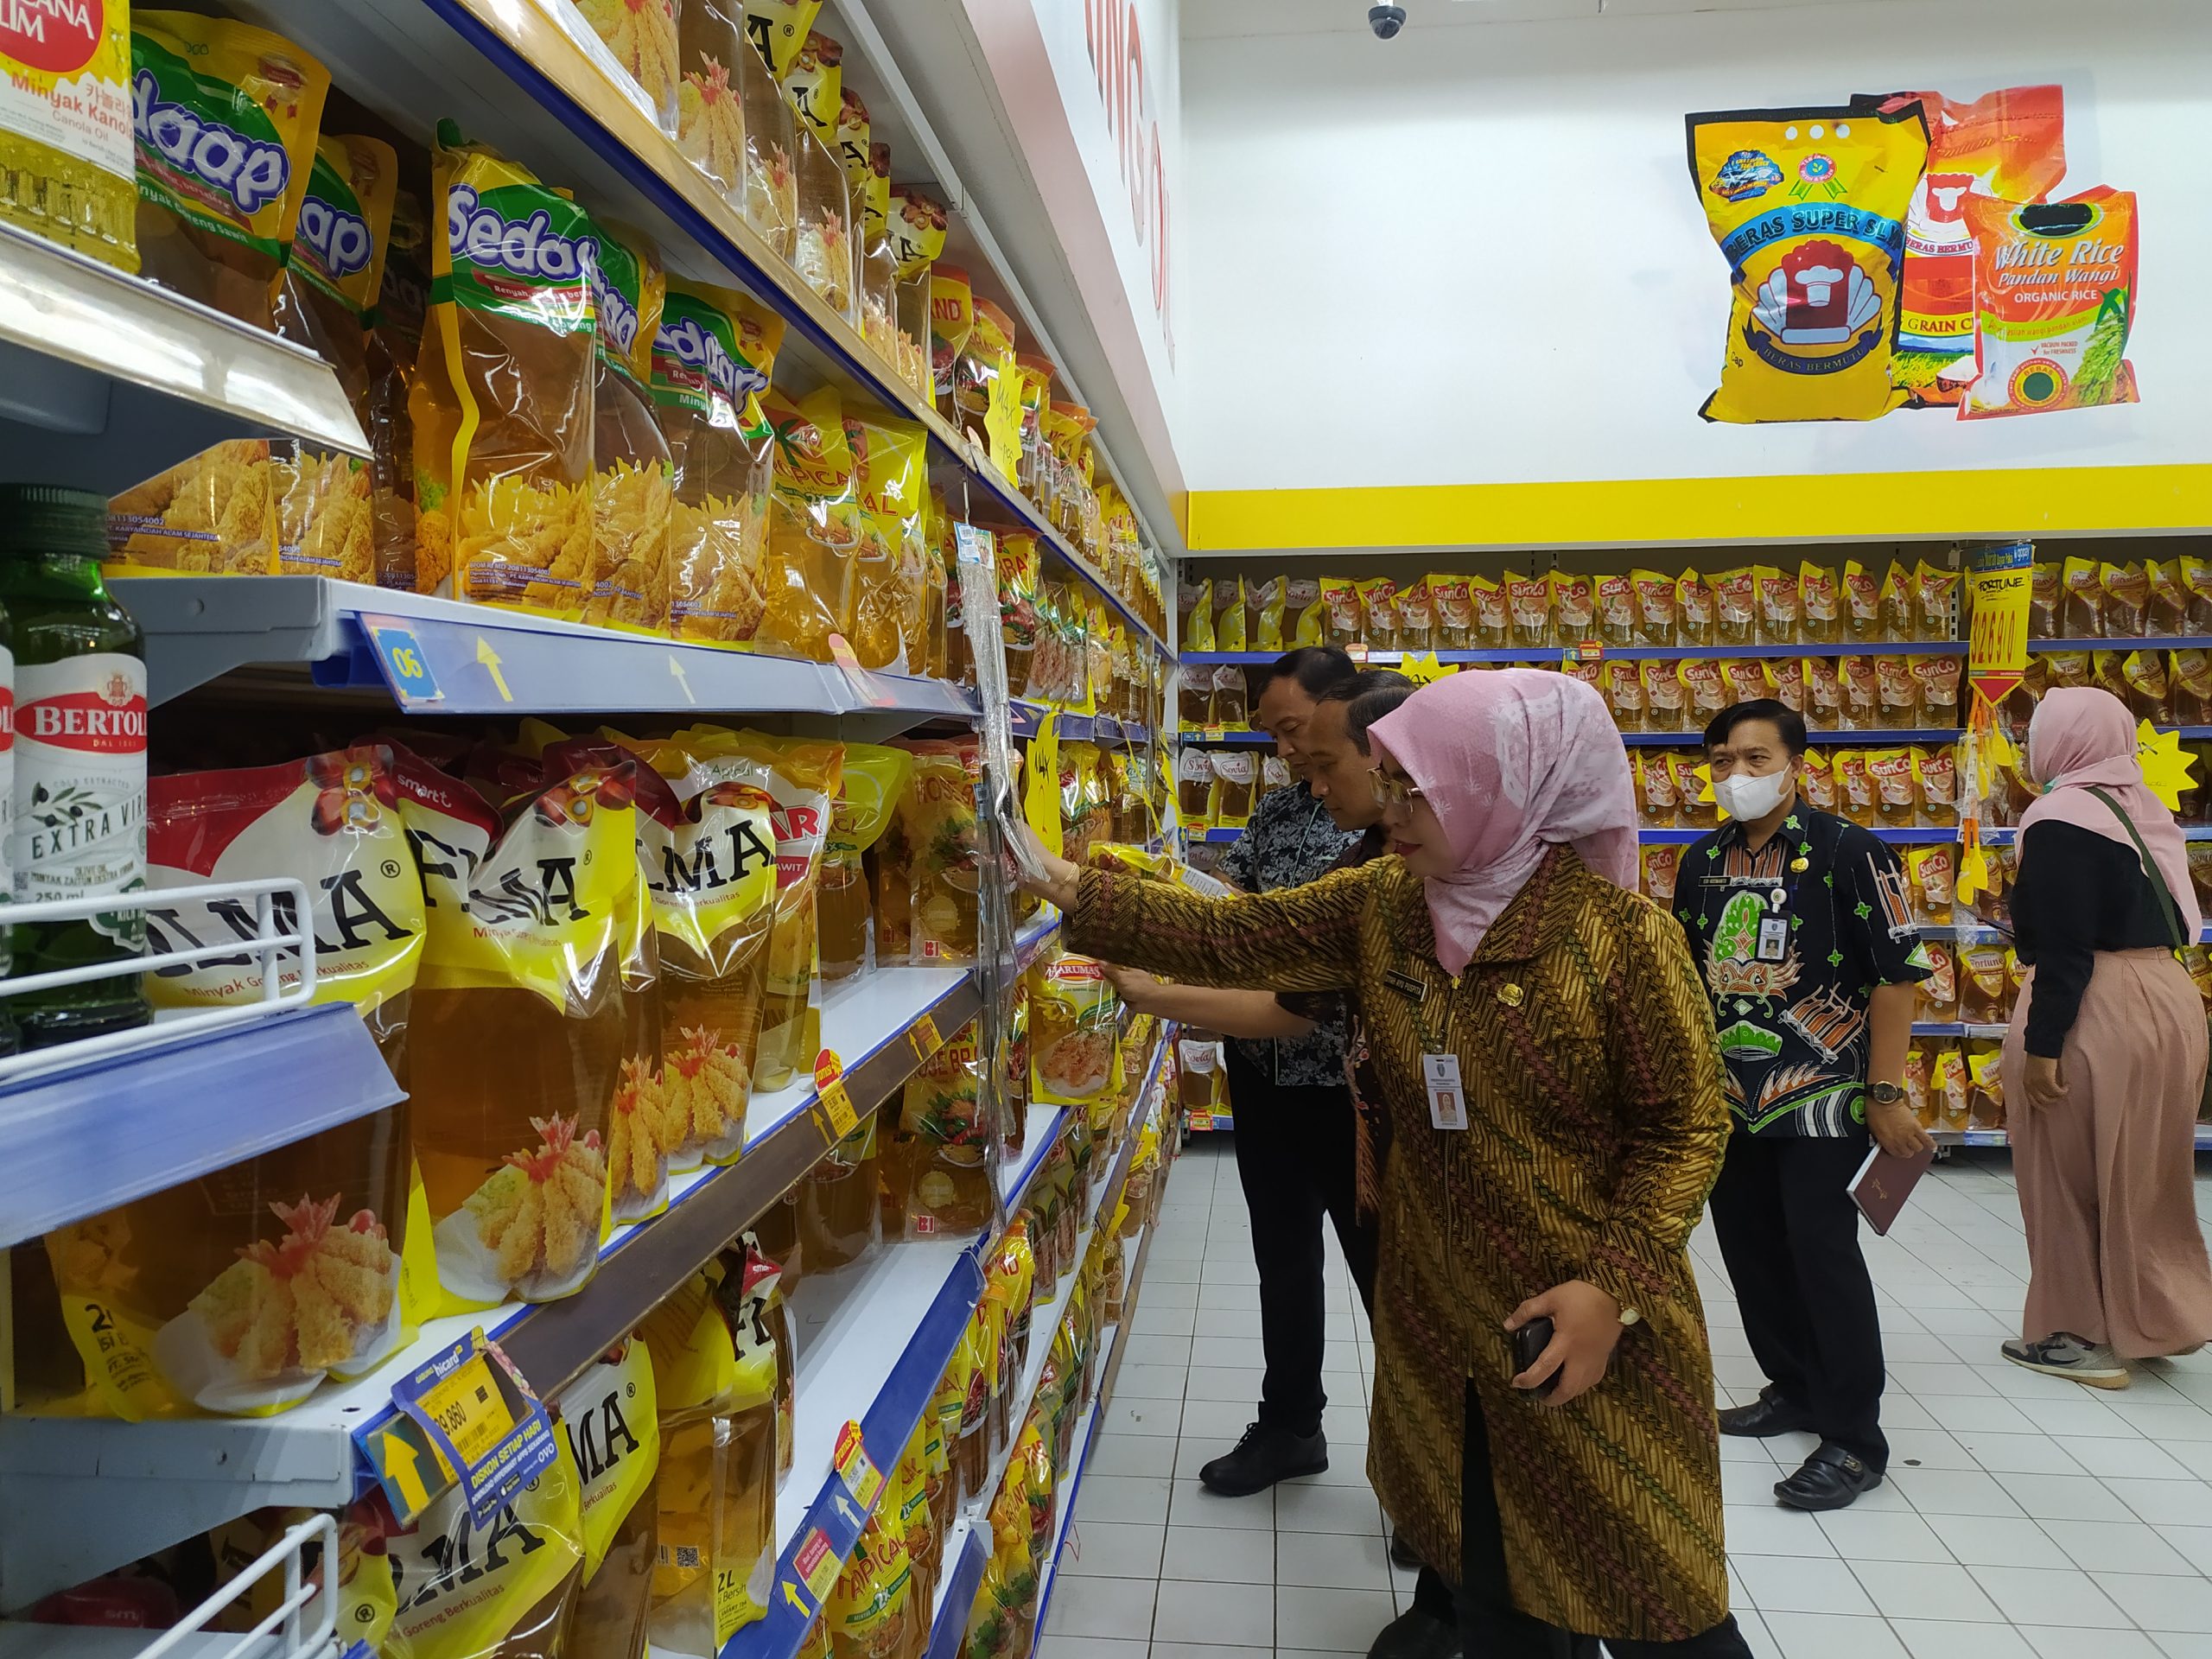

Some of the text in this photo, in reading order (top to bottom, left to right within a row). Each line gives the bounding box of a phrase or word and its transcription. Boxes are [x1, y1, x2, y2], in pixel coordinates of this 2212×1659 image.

[11, 72, 85, 115] Minyak
[88, 101, 133, 142] Kanola
[52, 110, 92, 136] Canola
[94, 128, 109, 143] Oil
[218, 225, 250, 244] Sawit
[1726, 209, 1859, 259] BERAS SUPER
[1906, 238, 1935, 253] BERAS
[1995, 238, 2126, 271] White Rice
[1998, 266, 2120, 289] Pandan Wangi
[2014, 289, 2098, 303] ORGANIC RICE
[1908, 316, 1957, 334] GRAIN
[1731, 351, 1745, 368] Cap
[1764, 347, 1865, 372] BERAS BERMUTU
[2023, 365, 2055, 378] BERAS
[115, 524, 162, 535] KARYAINDAH
[1435, 586, 1467, 601] SunCo
[1977, 576, 2025, 592] FORTUNE
[392, 646, 423, 679] 06
[1915, 660, 1955, 677] SunCo
[712, 764, 753, 779] Apical
[1223, 760, 1249, 775] Sovia
[1872, 758, 1911, 777] SunCo
[83, 778, 130, 790] EXTRACTED
[32, 810, 111, 860] EXTRA
[1919, 854, 1949, 877] SunCo
[30, 871, 62, 885] MINYAK
[64, 874, 92, 886] ZAITUN
[35, 892, 62, 902] 250
[1970, 953, 2005, 968] Fortune
[183, 978, 244, 998] Minyak
[433, 1352, 461, 1377] hicard
[469, 1418, 543, 1489] DISKON SETIAP HARI
[537, 1442, 556, 1464] OVO
[471, 1476, 495, 1506] DOWNLOAD
[583, 1480, 618, 1512] Berkualitas
[717, 1569, 735, 1594] 2L
[722, 1583, 747, 1605] Bersih
[874, 1583, 893, 1611] 2X
[403, 1582, 505, 1639] Goreng Berkualitas
